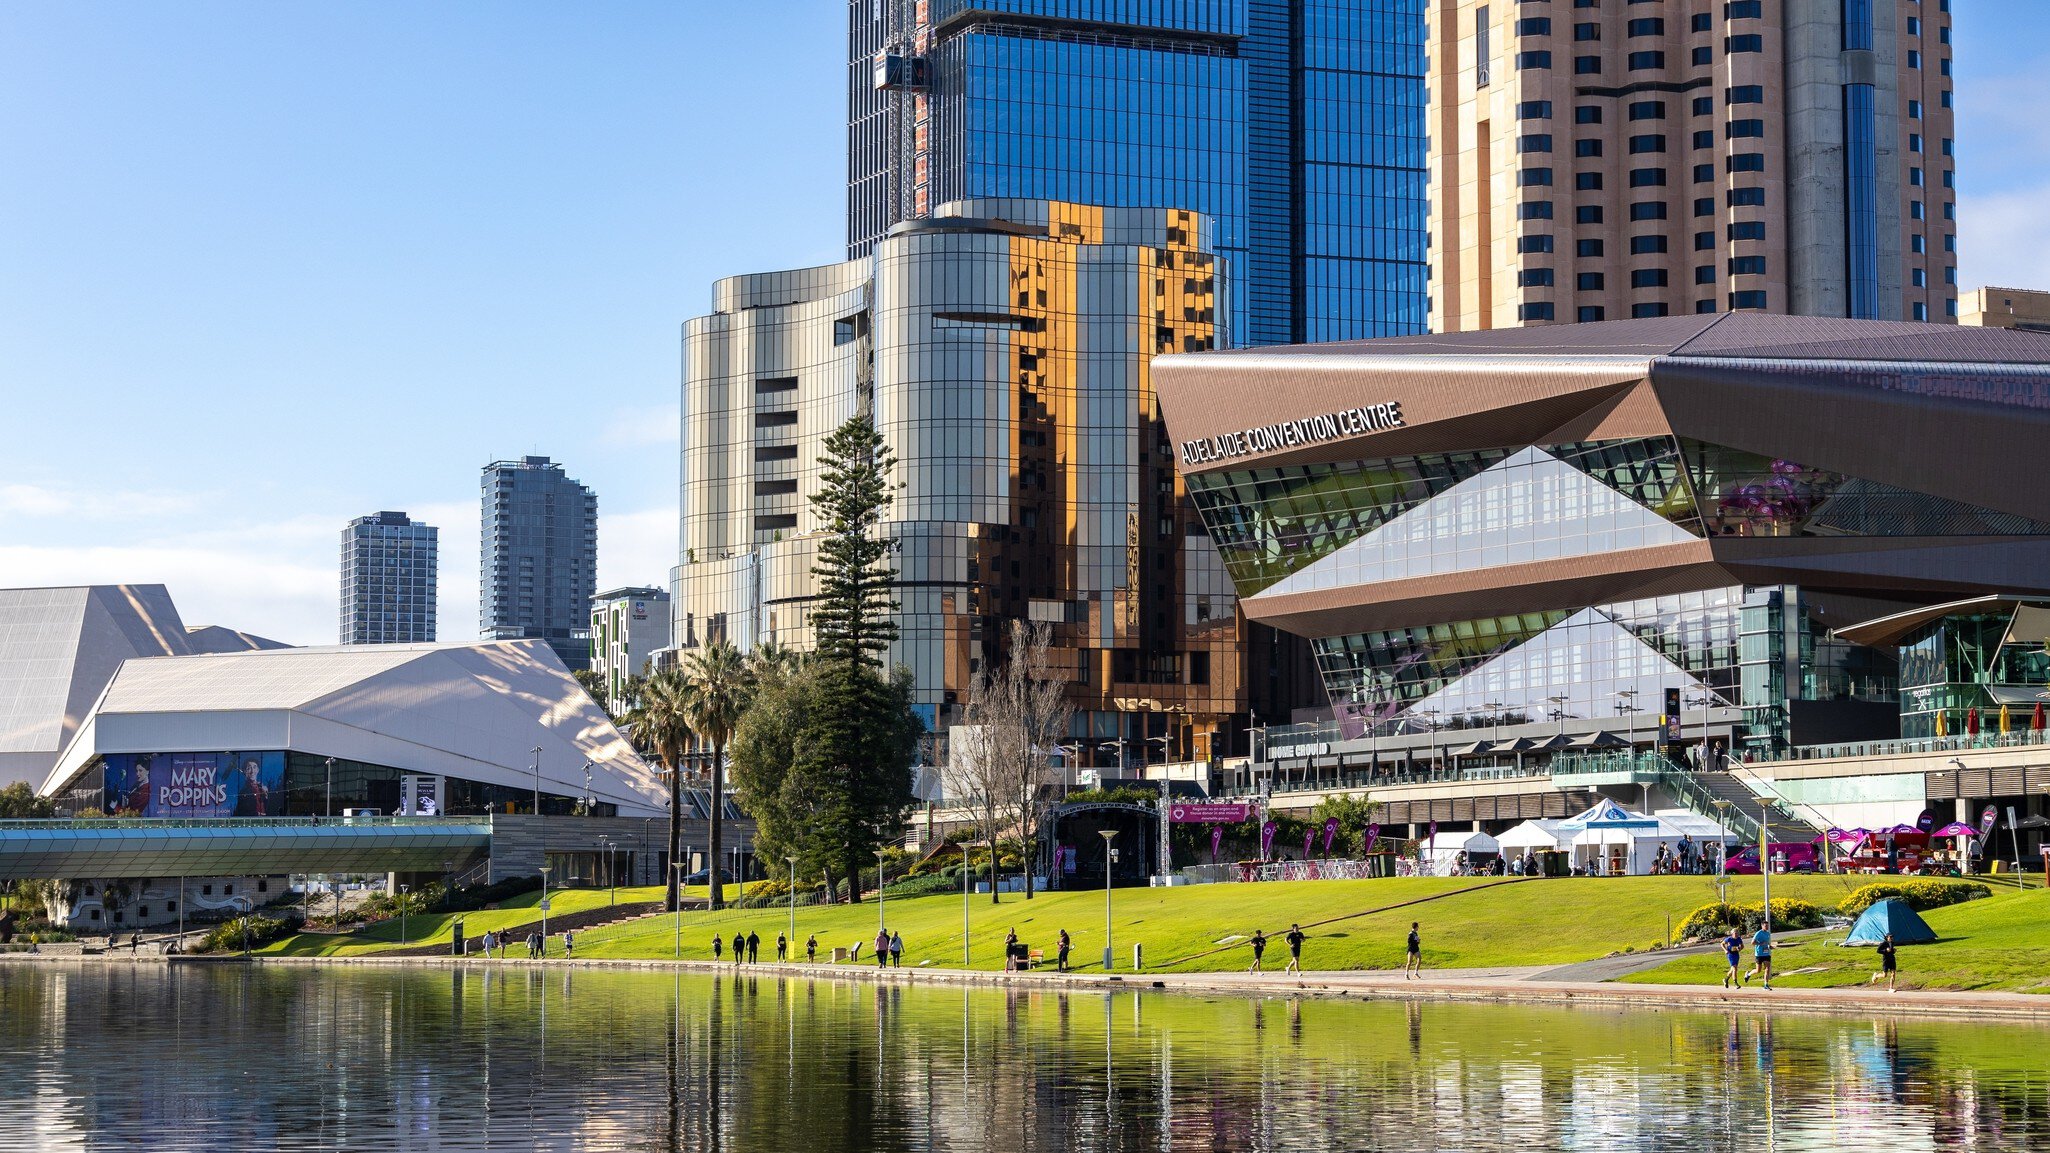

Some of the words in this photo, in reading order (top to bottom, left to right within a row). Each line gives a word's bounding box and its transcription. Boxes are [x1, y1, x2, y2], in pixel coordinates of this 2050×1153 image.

[1181, 432, 1247, 464] ADELAIDE
[1246, 413, 1338, 452] CONVENTION
[1338, 401, 1401, 434] CENTRE
[1271, 745, 1294, 758] HOME
[1295, 743, 1327, 757] GROUND
[171, 766, 217, 786] MARY
[160, 784, 227, 806] POPPINS
